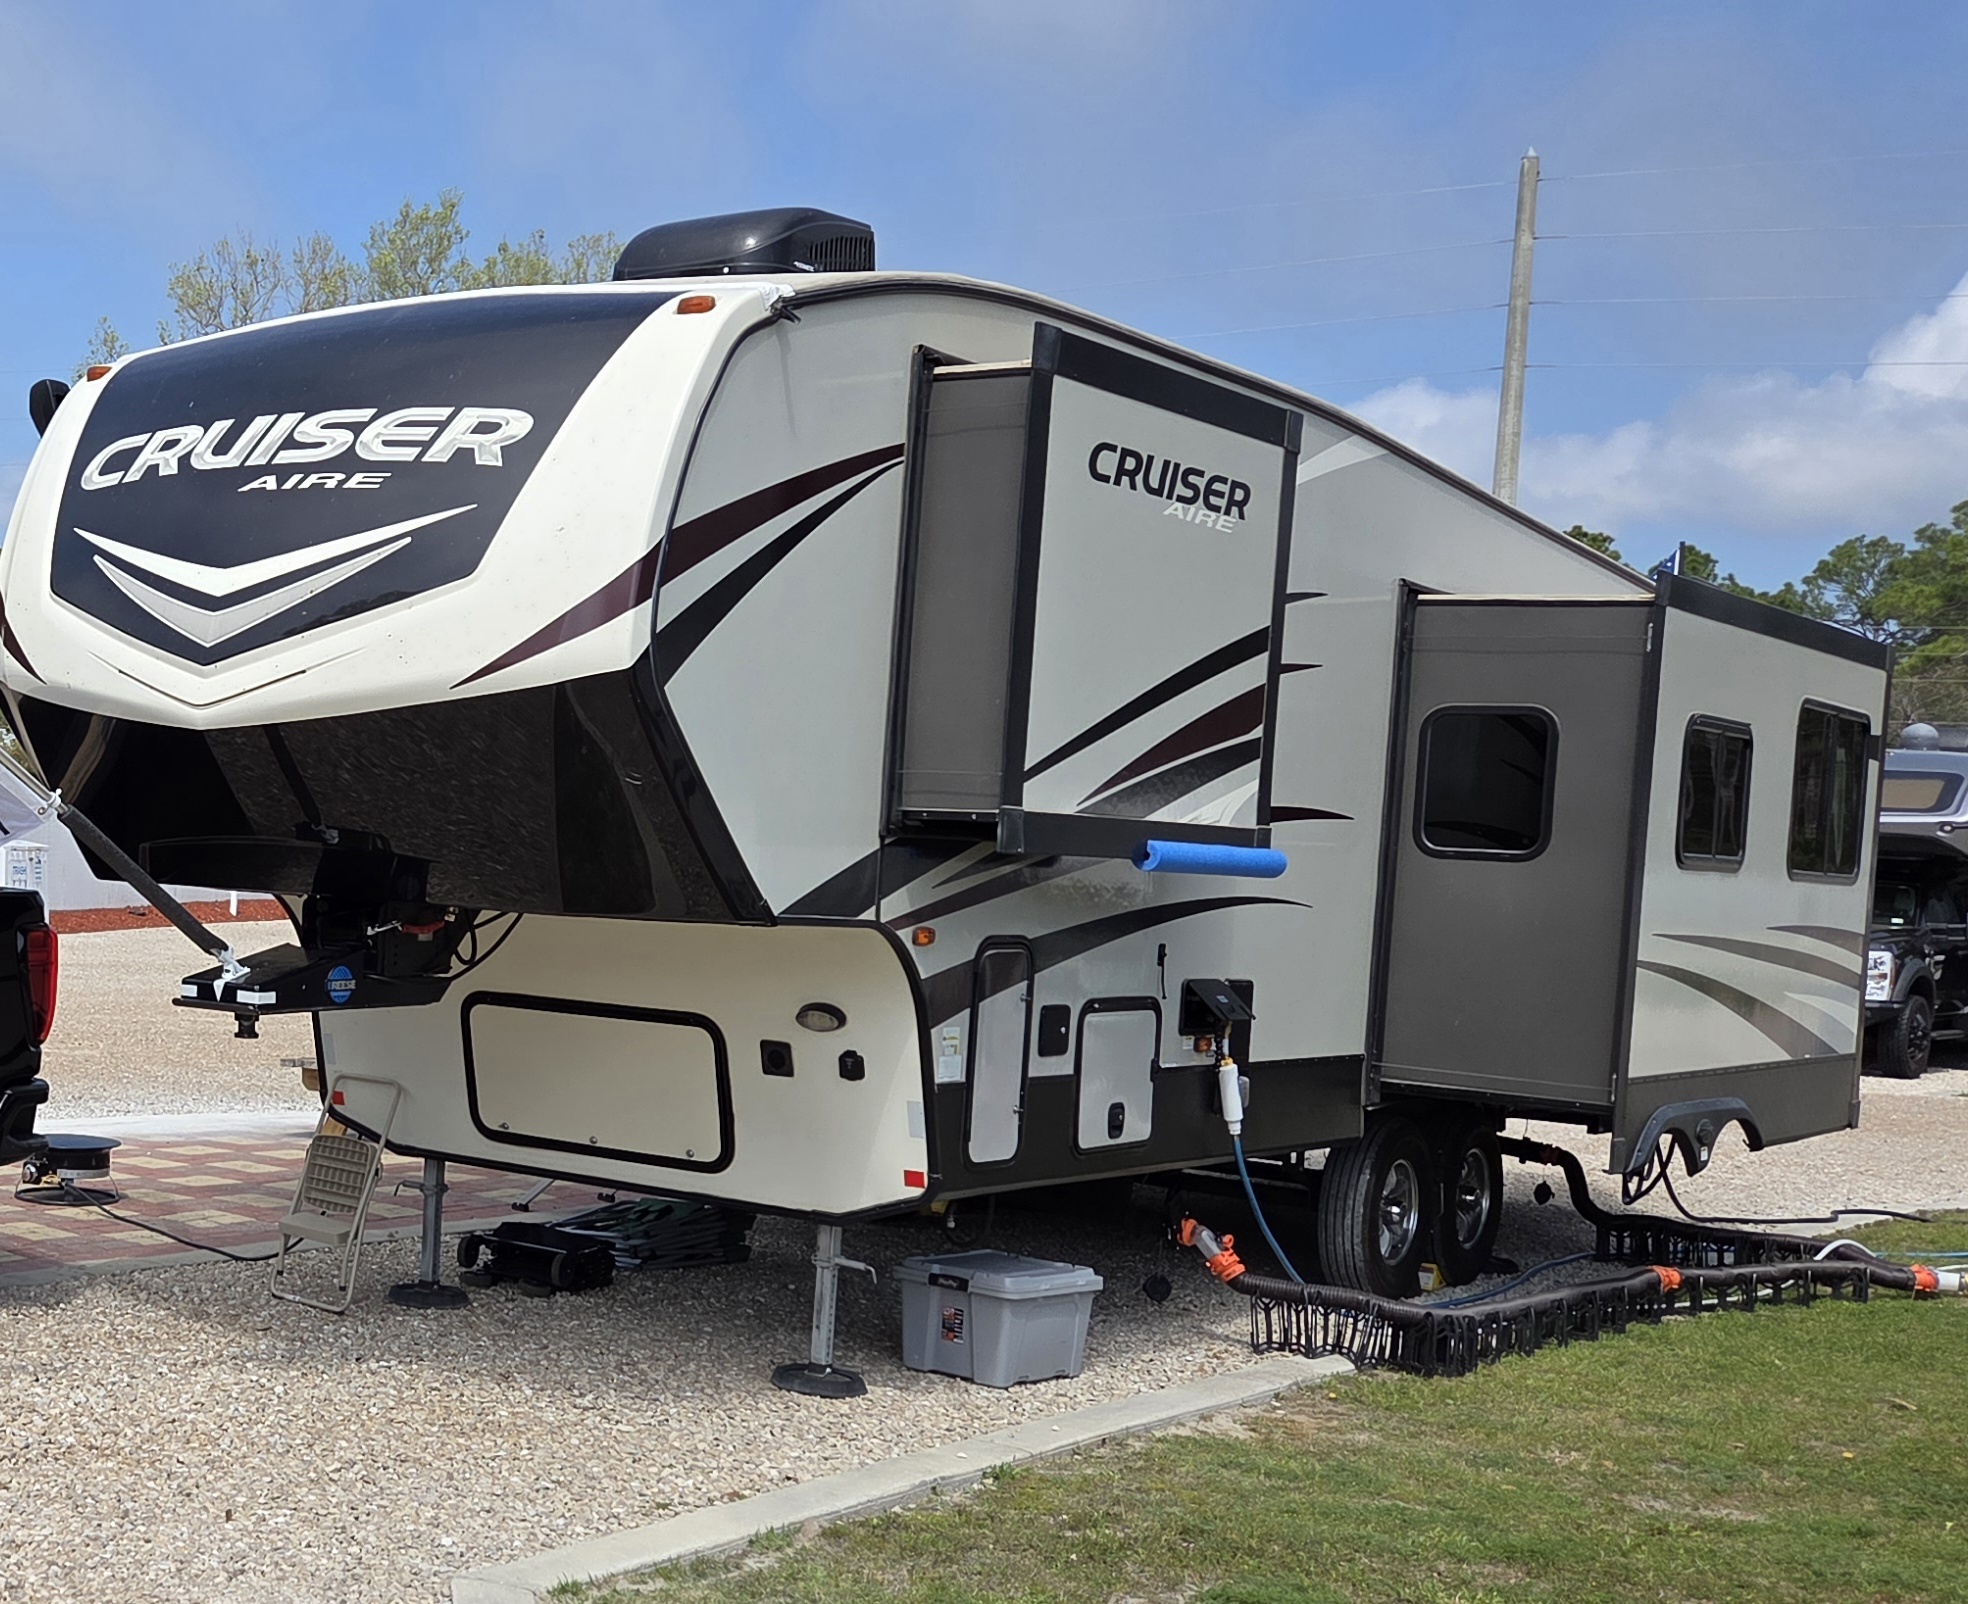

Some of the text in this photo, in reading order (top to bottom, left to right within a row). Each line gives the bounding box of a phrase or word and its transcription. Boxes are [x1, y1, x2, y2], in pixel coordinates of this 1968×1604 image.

[80, 406, 535, 491] CRUISER
[237, 472, 392, 493] AIRE
[1088, 441, 1252, 521] CRUISER
[1162, 502, 1238, 534] AIRE
[331, 979, 356, 990] REESE
